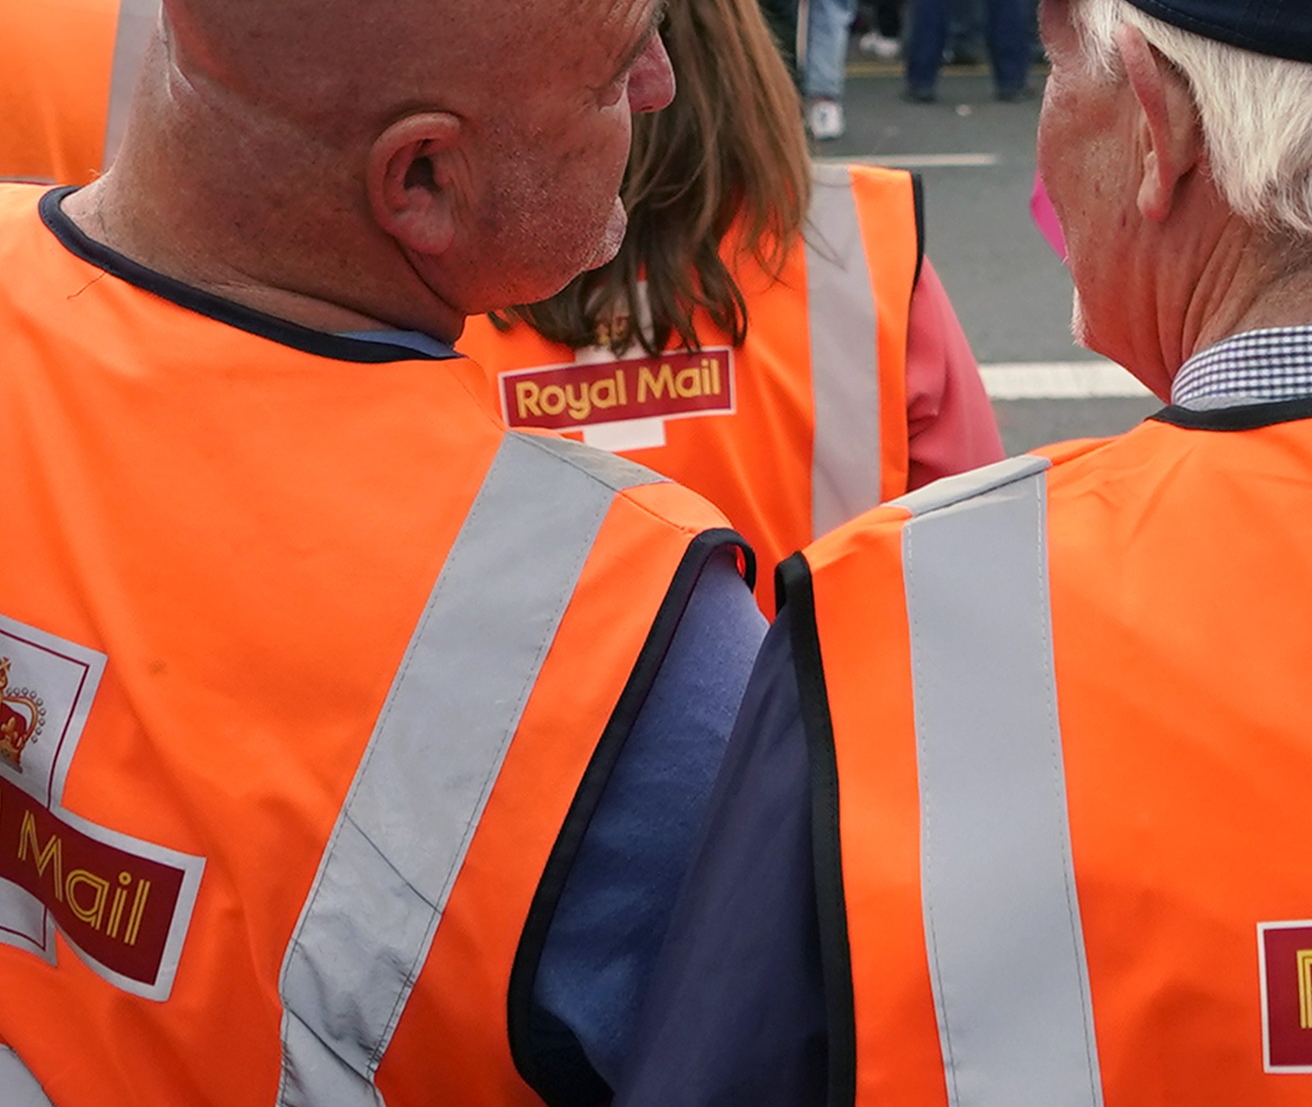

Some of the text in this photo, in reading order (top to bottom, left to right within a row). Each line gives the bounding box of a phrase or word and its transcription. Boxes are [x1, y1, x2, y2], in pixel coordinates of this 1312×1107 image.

[515, 358, 722, 420] Royal Mail
[17, 809, 151, 947] Mail
